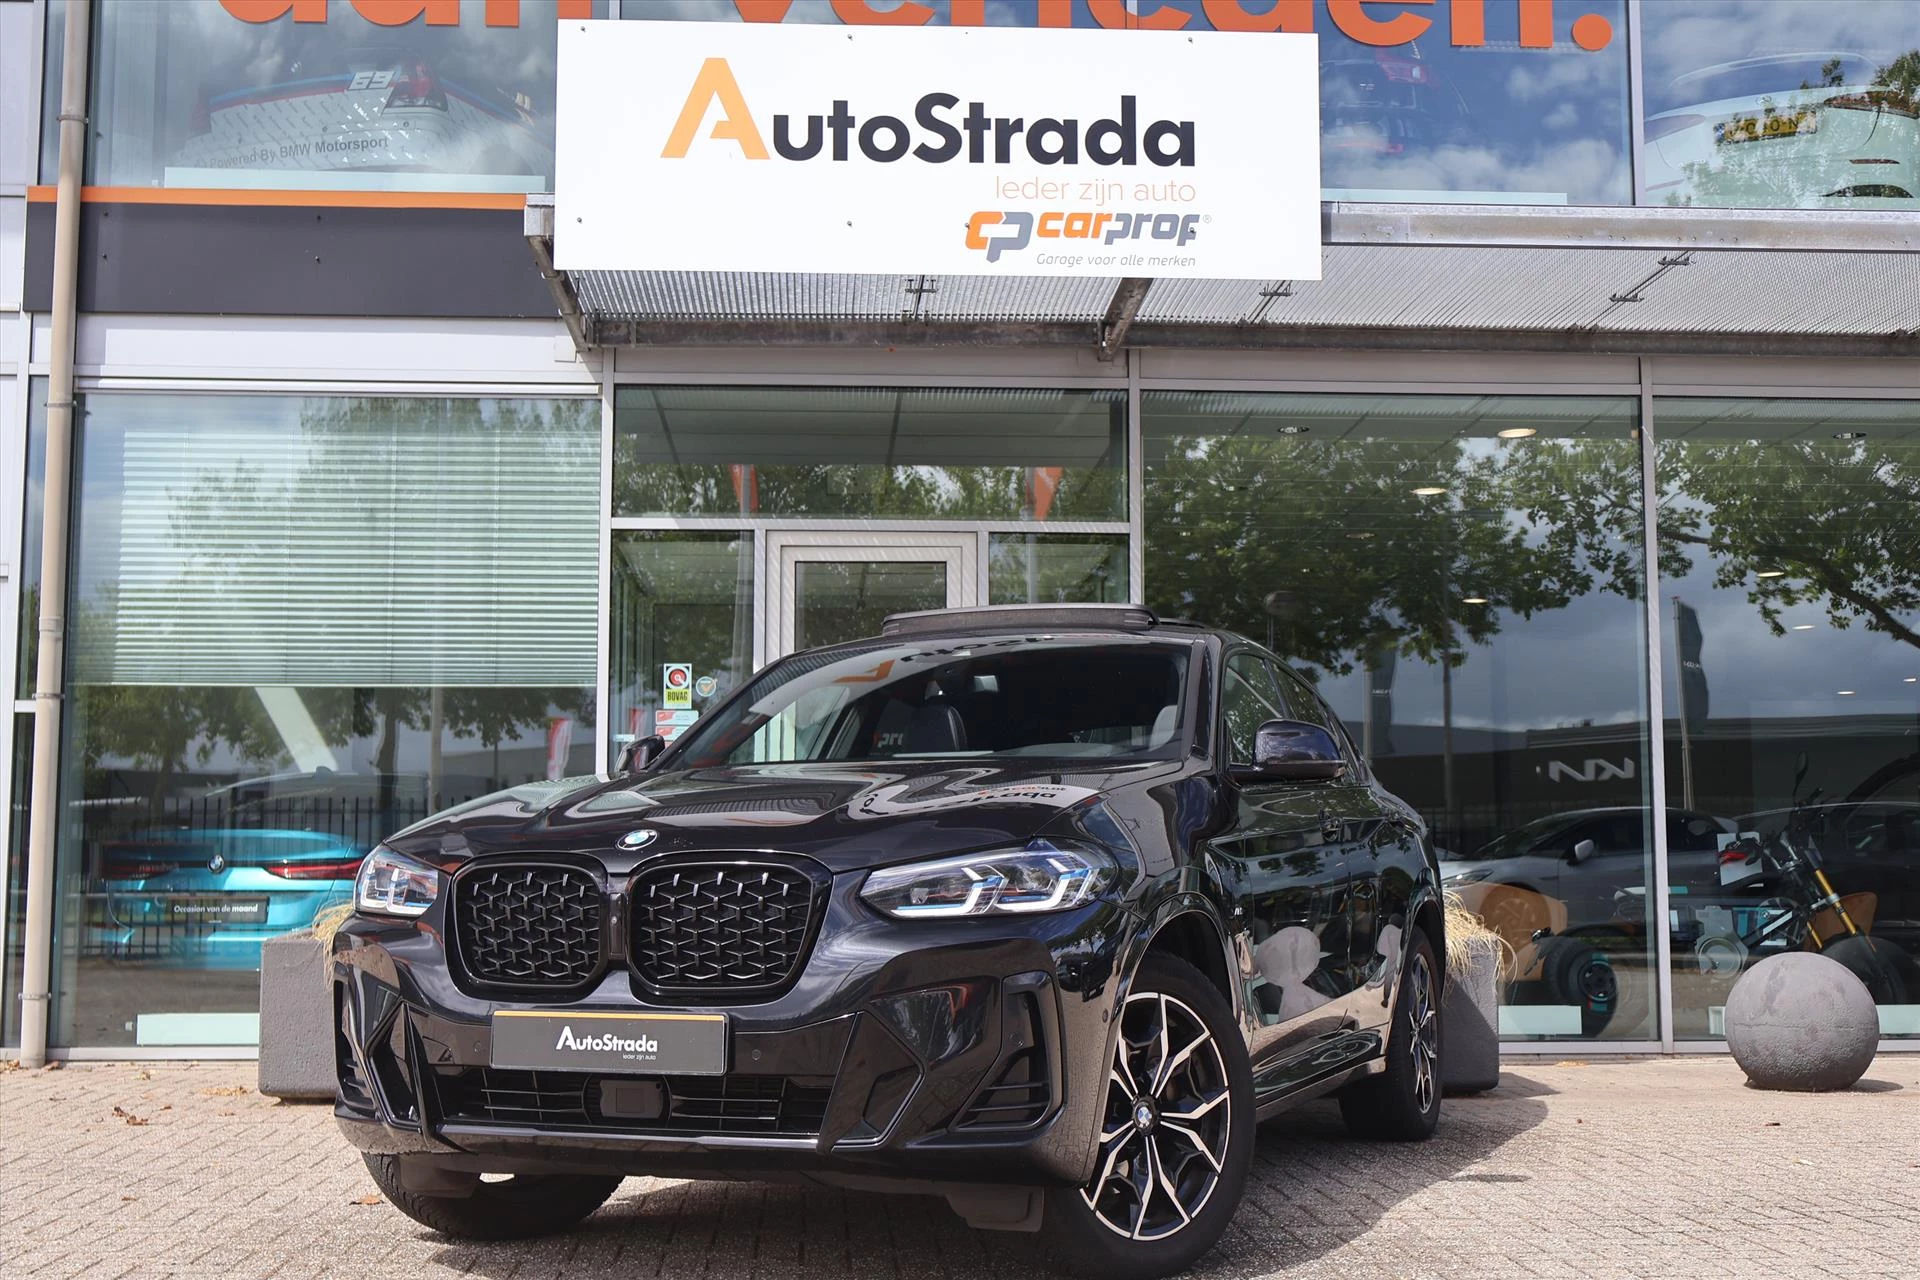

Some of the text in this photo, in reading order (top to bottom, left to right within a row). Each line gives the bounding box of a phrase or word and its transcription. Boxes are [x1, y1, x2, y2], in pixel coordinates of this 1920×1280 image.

[348, 71, 394, 90] 69
[660, 57, 1196, 167] AutoStrada
[210, 138, 390, 169] Powered By BMW Motorsport
[996, 176, 1196, 206] Ieder zijn auto
[1037, 253, 1196, 268] Garage voor alle merken
[667, 691, 688, 701] BOVAG
[174, 903, 259, 913] Occasion van de maand
[556, 1025, 658, 1052] AutoStrada
